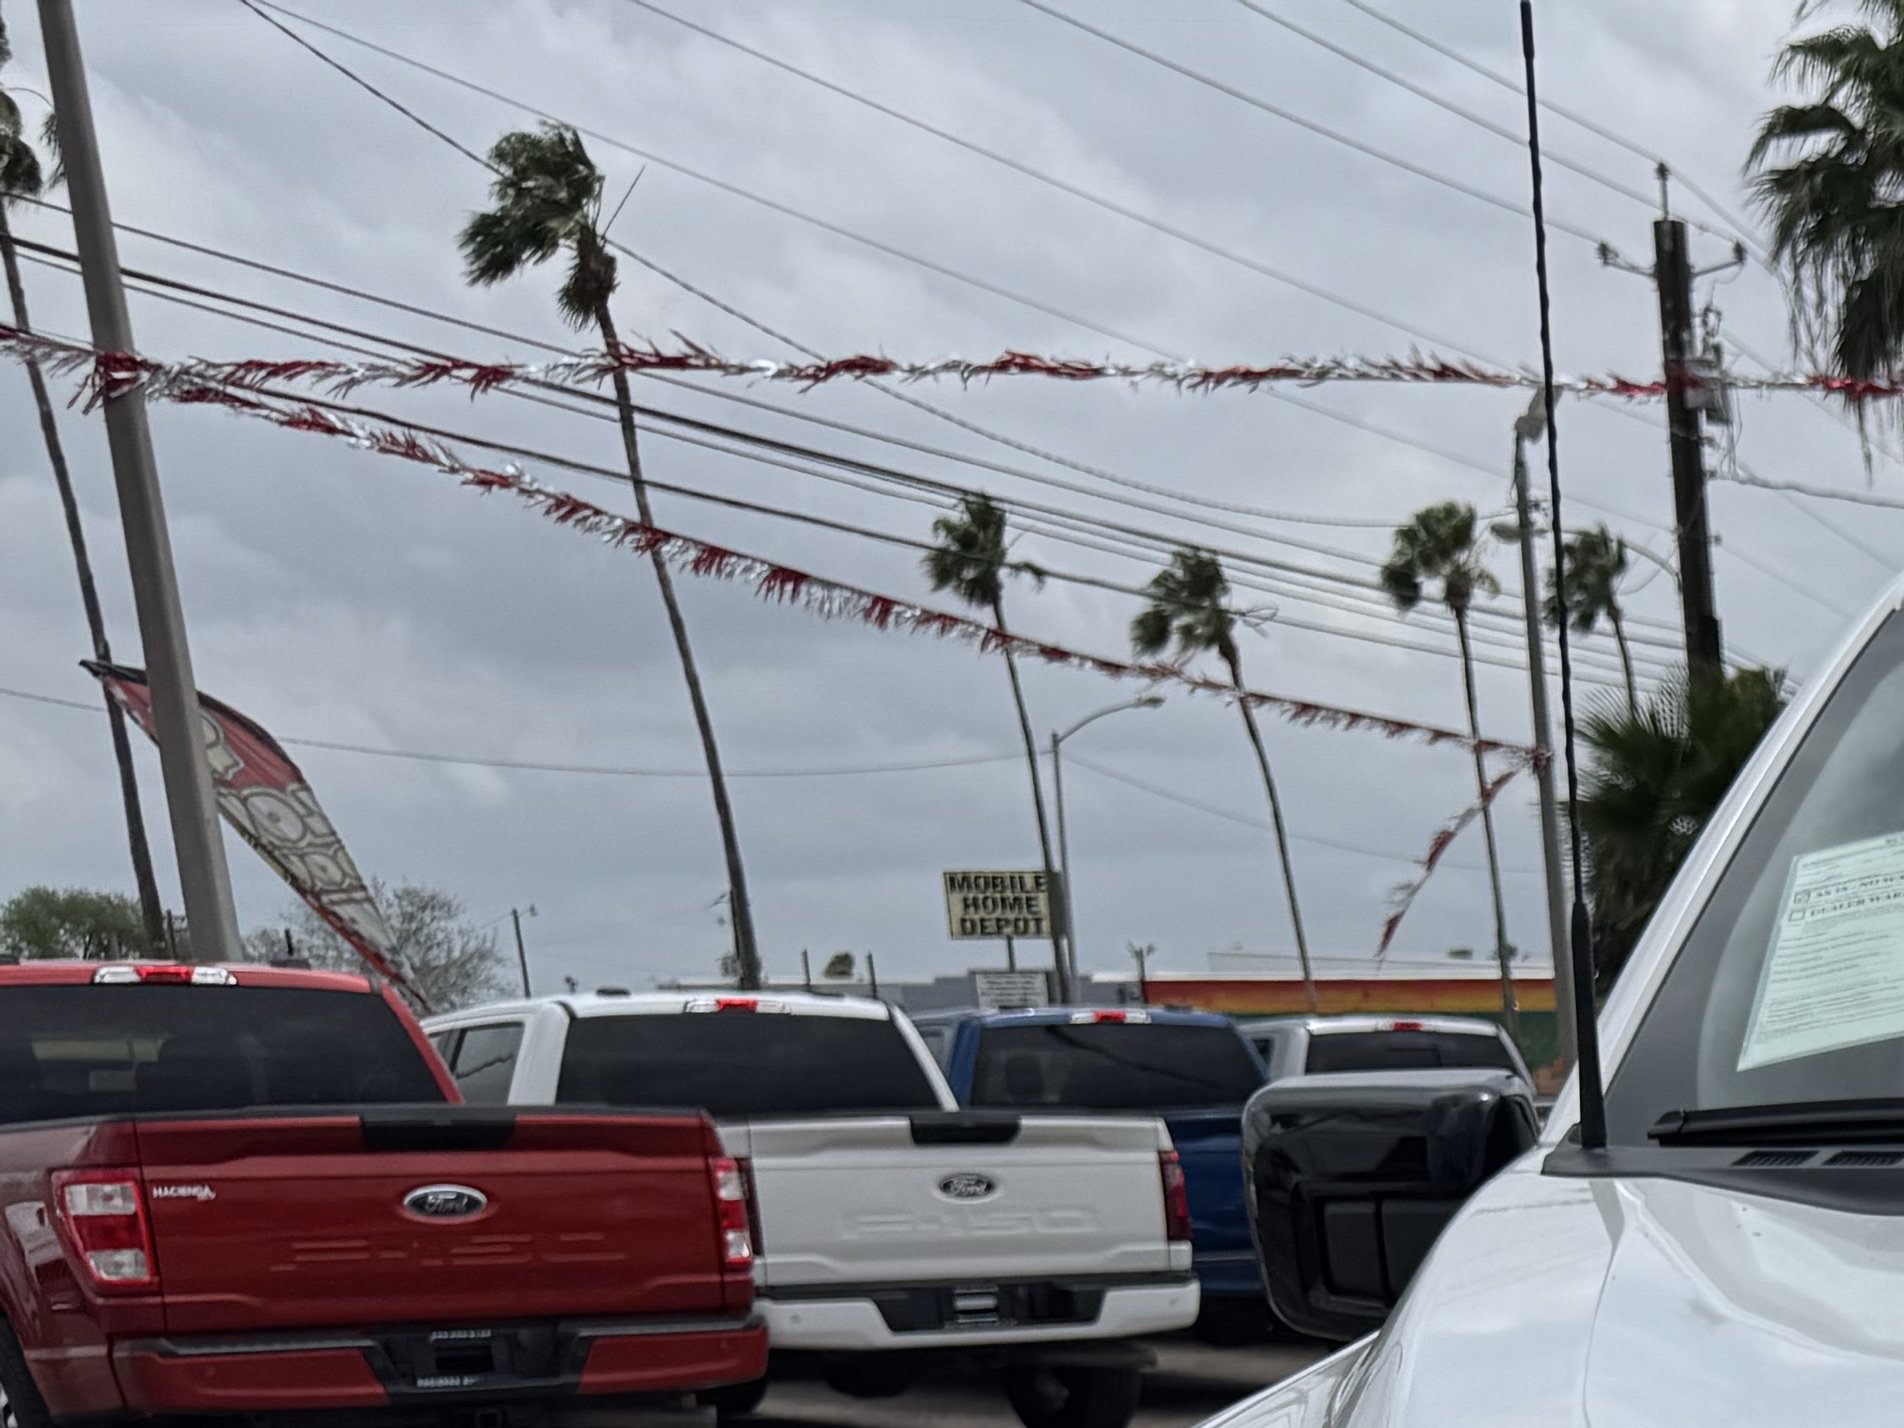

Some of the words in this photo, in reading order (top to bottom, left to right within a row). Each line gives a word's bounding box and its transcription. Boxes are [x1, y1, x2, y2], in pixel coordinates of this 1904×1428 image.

[948, 875, 1047, 894] MOBILE
[962, 895, 1040, 916] HOME
[959, 917, 1043, 936] DEPOT
[424, 1192, 470, 1213] Ford
